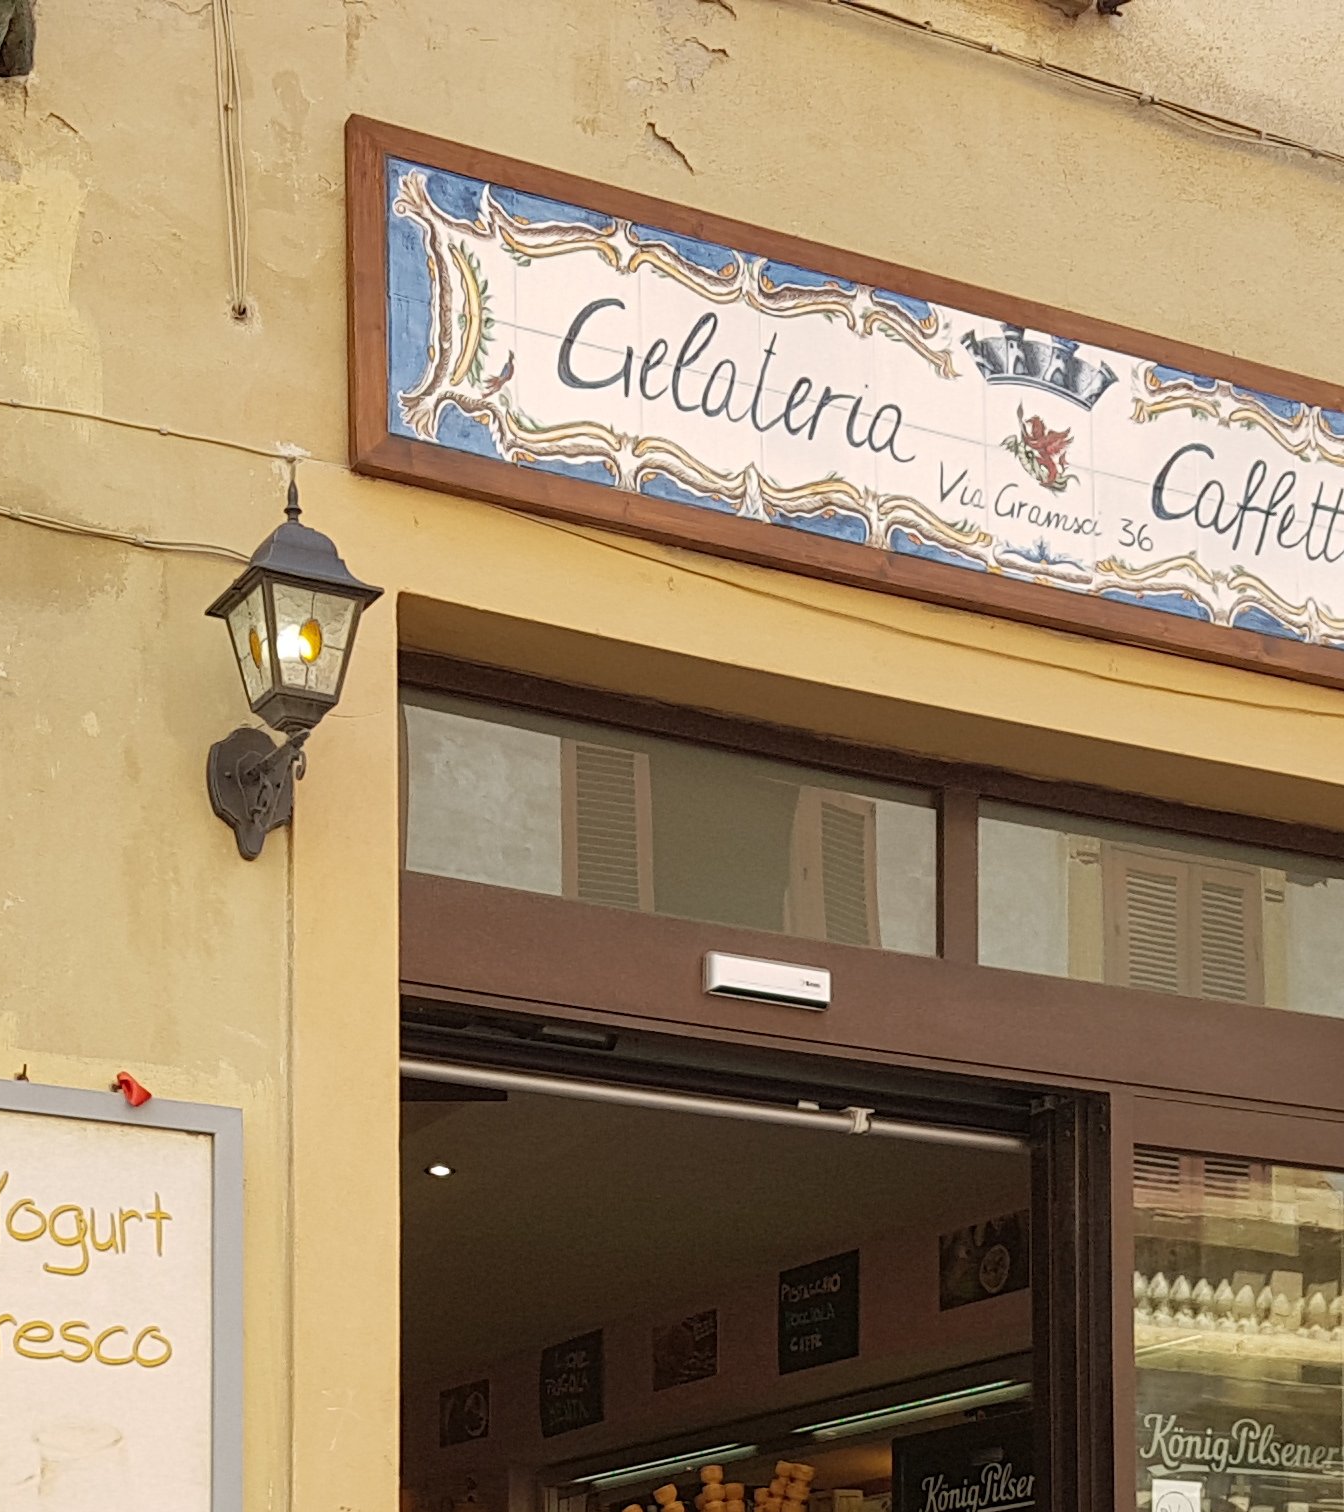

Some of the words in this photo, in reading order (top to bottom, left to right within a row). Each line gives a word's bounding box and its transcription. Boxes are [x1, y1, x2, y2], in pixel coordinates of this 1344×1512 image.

[556, 297, 917, 464] Gelateria
[938, 460, 985, 510] Via
[993, 482, 1103, 537] Gramsci
[1117, 517, 1154, 552] 36
